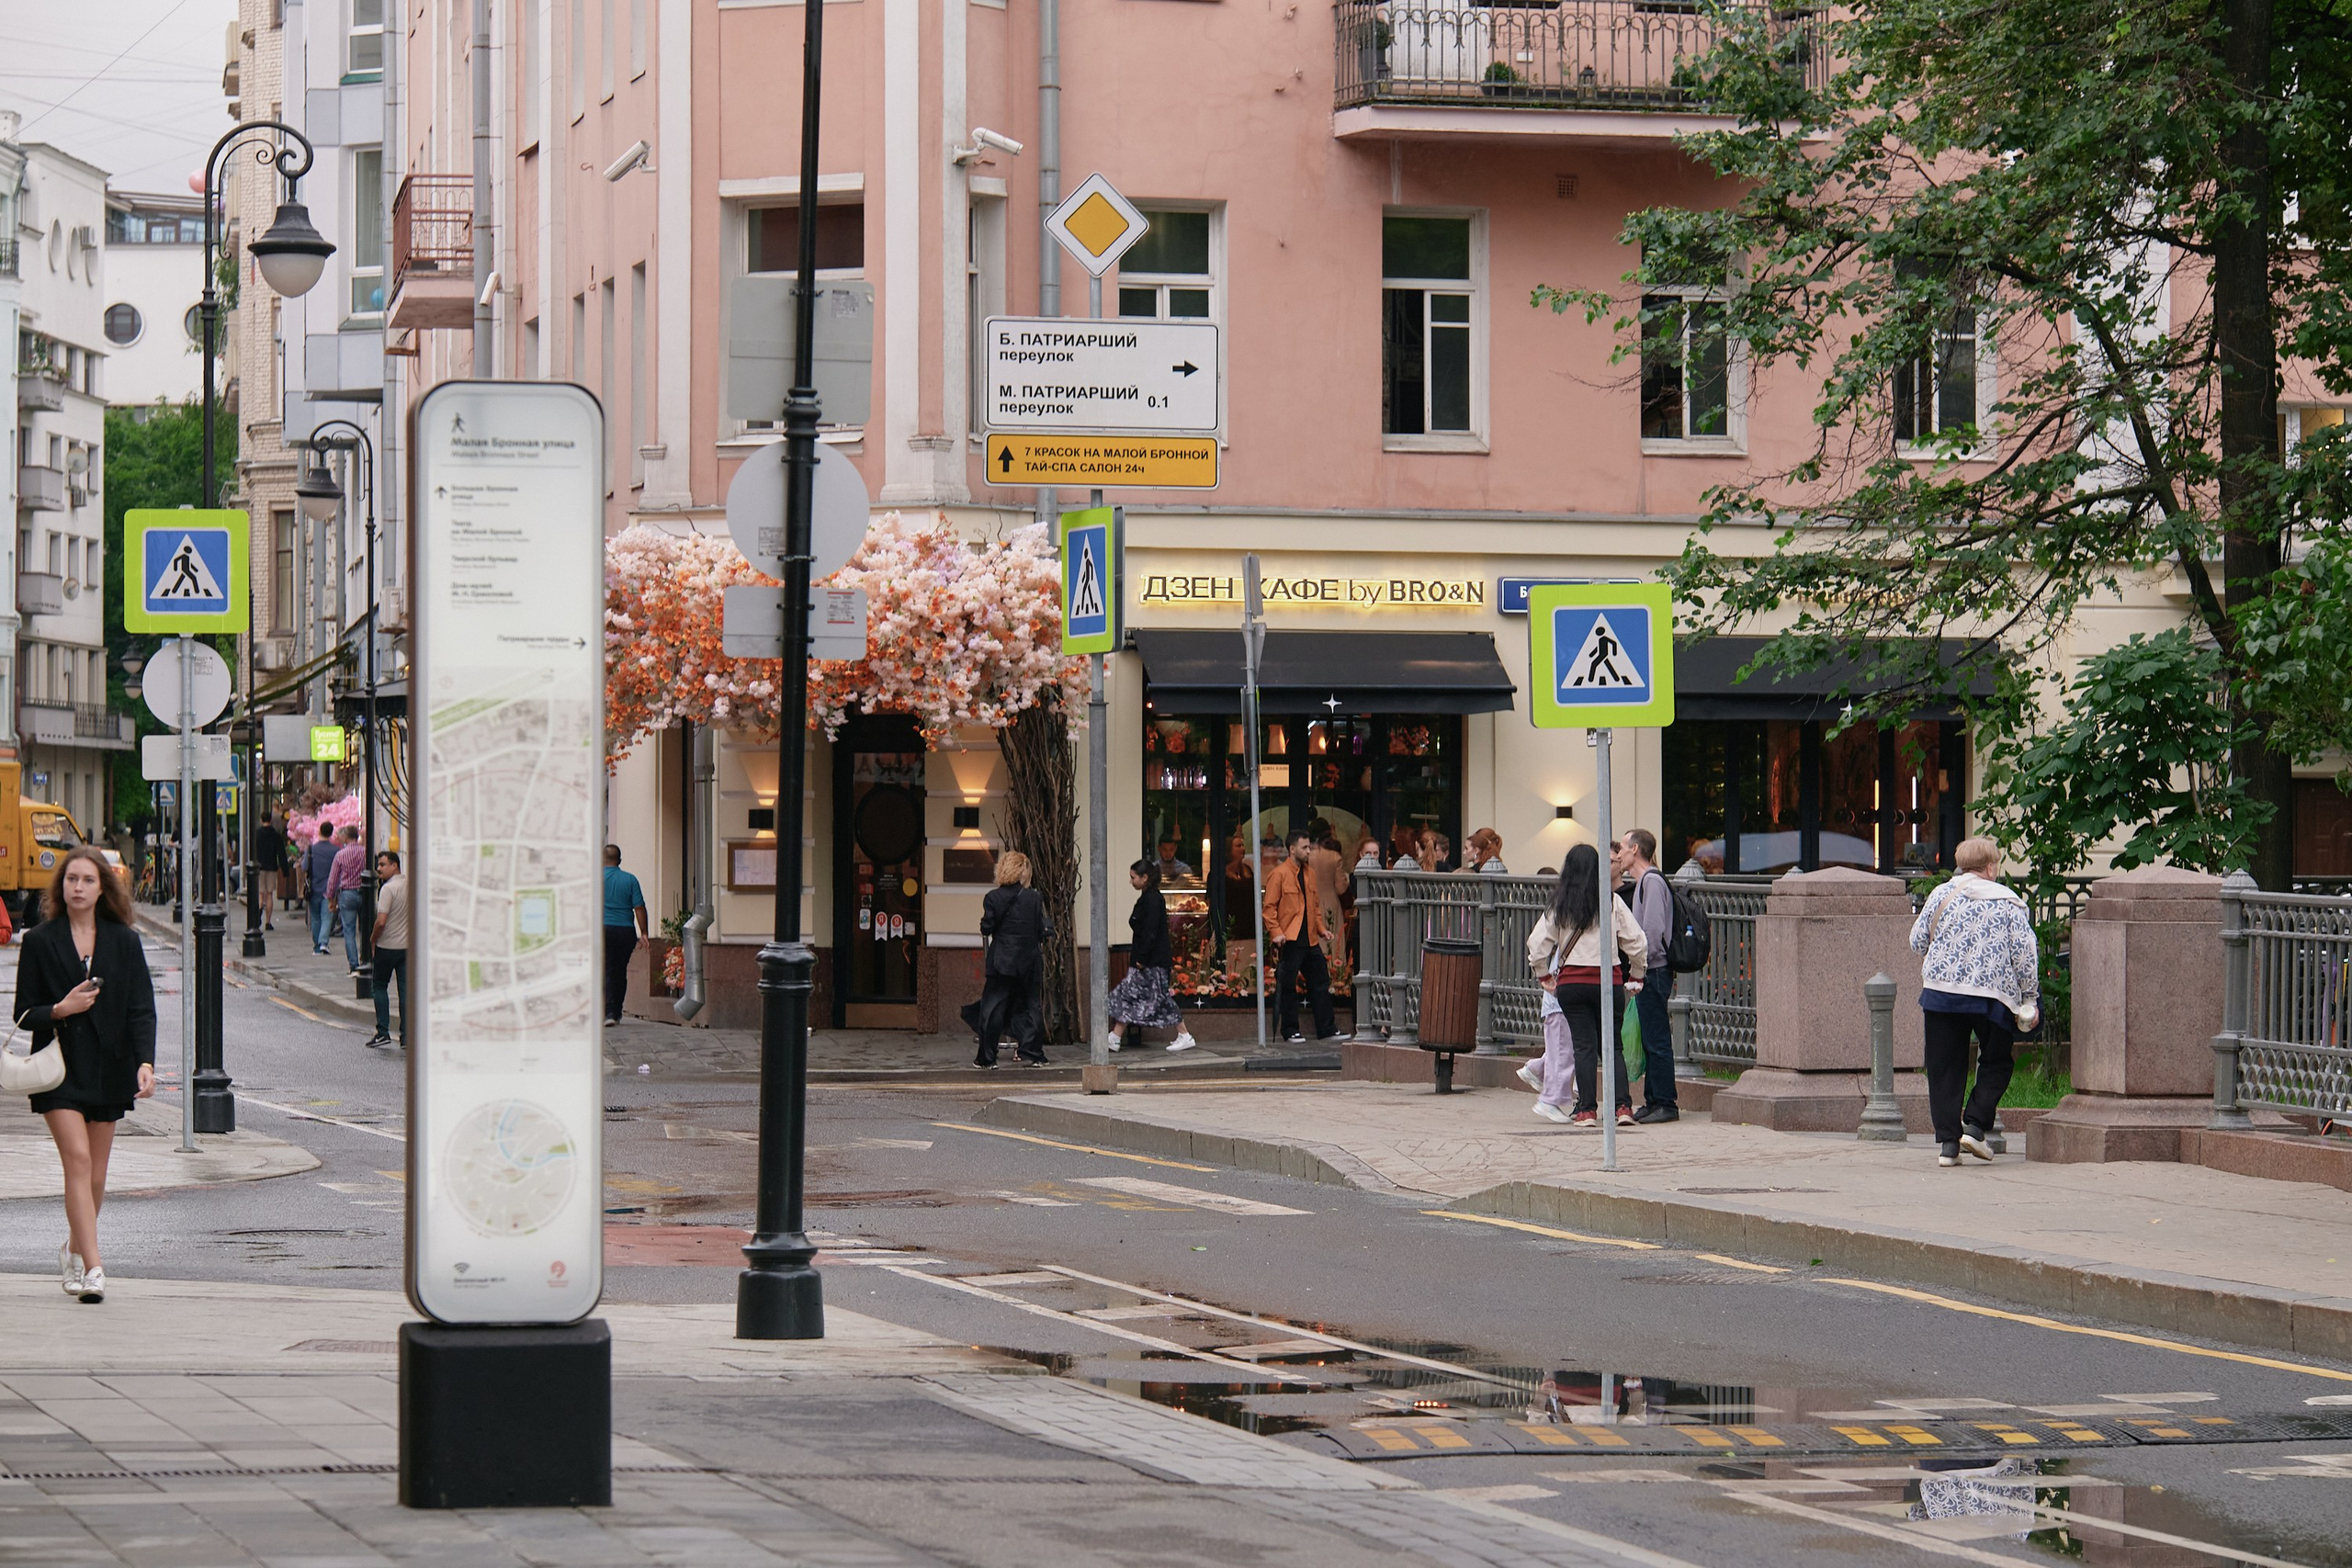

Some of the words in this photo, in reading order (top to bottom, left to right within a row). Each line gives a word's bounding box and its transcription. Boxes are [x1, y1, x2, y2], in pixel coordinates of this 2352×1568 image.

[1000, 333, 1015, 345] Б.
[1021, 333, 1137, 348] ПАТРИАРШИЙ
[1000, 351, 1074, 364] переулок
[1000, 384, 1017, 398] М.
[1022, 384, 1138, 400] ПАТРИАРШИЙ
[1148, 395, 1169, 408] 0.1
[1000, 403, 1074, 417] переулок
[1024, 446, 1031, 457] 7
[1035, 447, 1080, 458] КРАСОК
[1083, 449, 1101, 458] НА
[1103, 446, 1148, 459] МАЛОЙ
[1150, 447, 1209, 460] БРОННОЙ
[1024, 460, 1077, 472] ТАЙ-СПА
[1080, 462, 1122, 473] САЛОН
[1125, 464, 1145, 474] 24ч
[1143, 576, 1234, 602] ДЗЕН
[1349, 579, 1383, 608] by
[1388, 580, 1485, 604] BRO&N
[317, 743, 340, 758] 24
